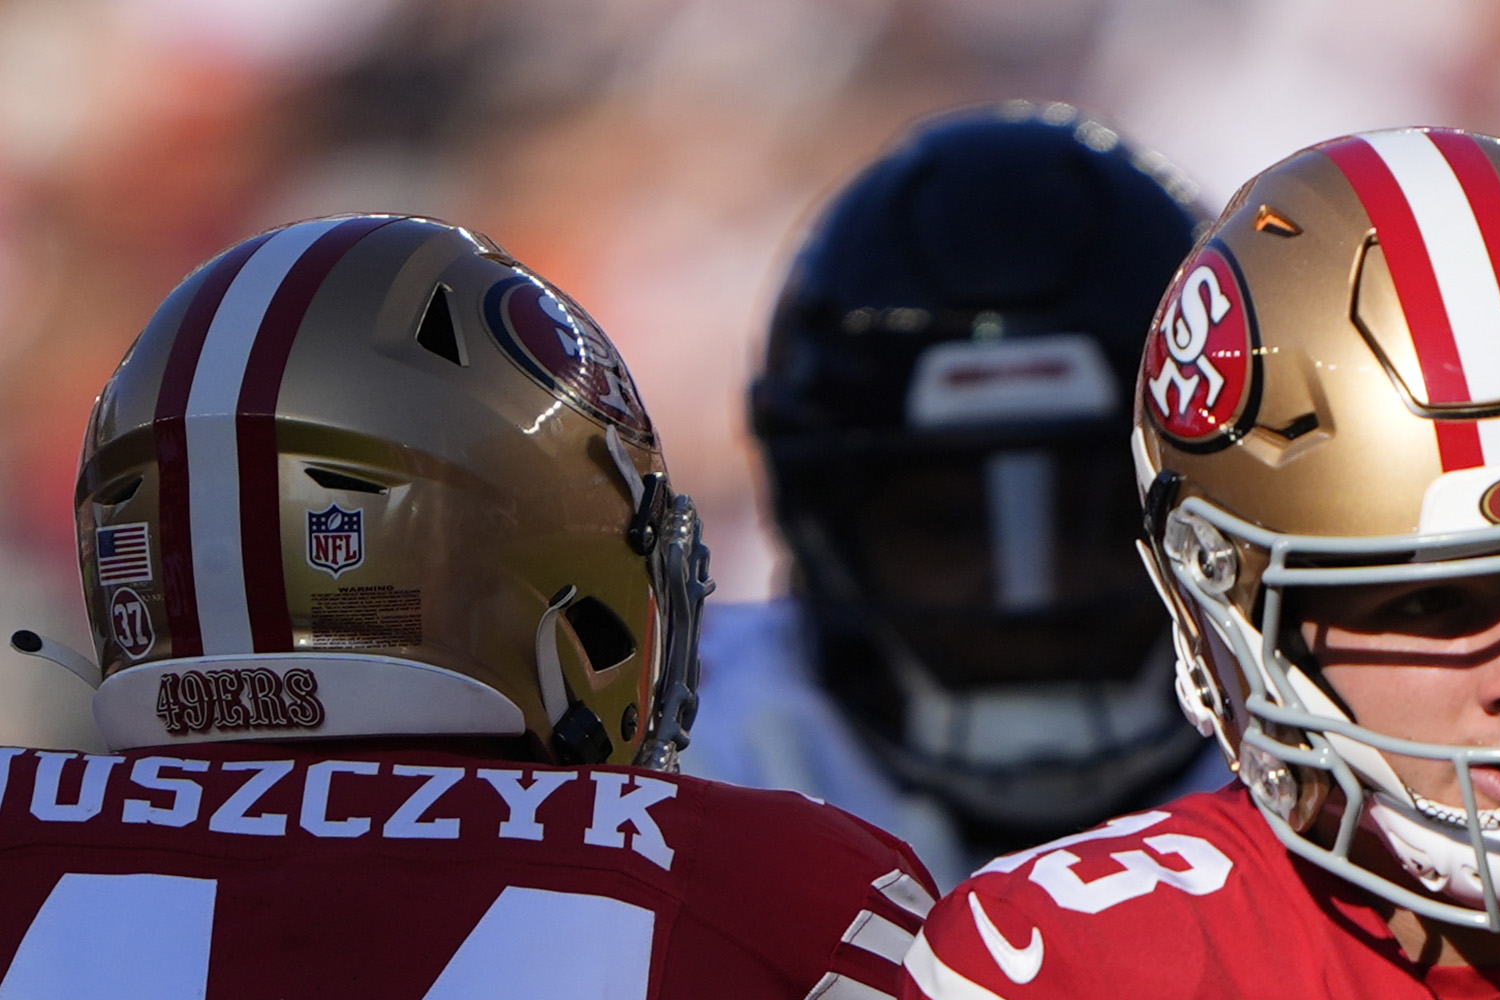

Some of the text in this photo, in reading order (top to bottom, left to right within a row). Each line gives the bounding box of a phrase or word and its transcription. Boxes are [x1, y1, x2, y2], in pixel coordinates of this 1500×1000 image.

[313, 534, 357, 565] NFL
[114, 601, 148, 647] 37
[156, 667, 325, 734] 49ERS
